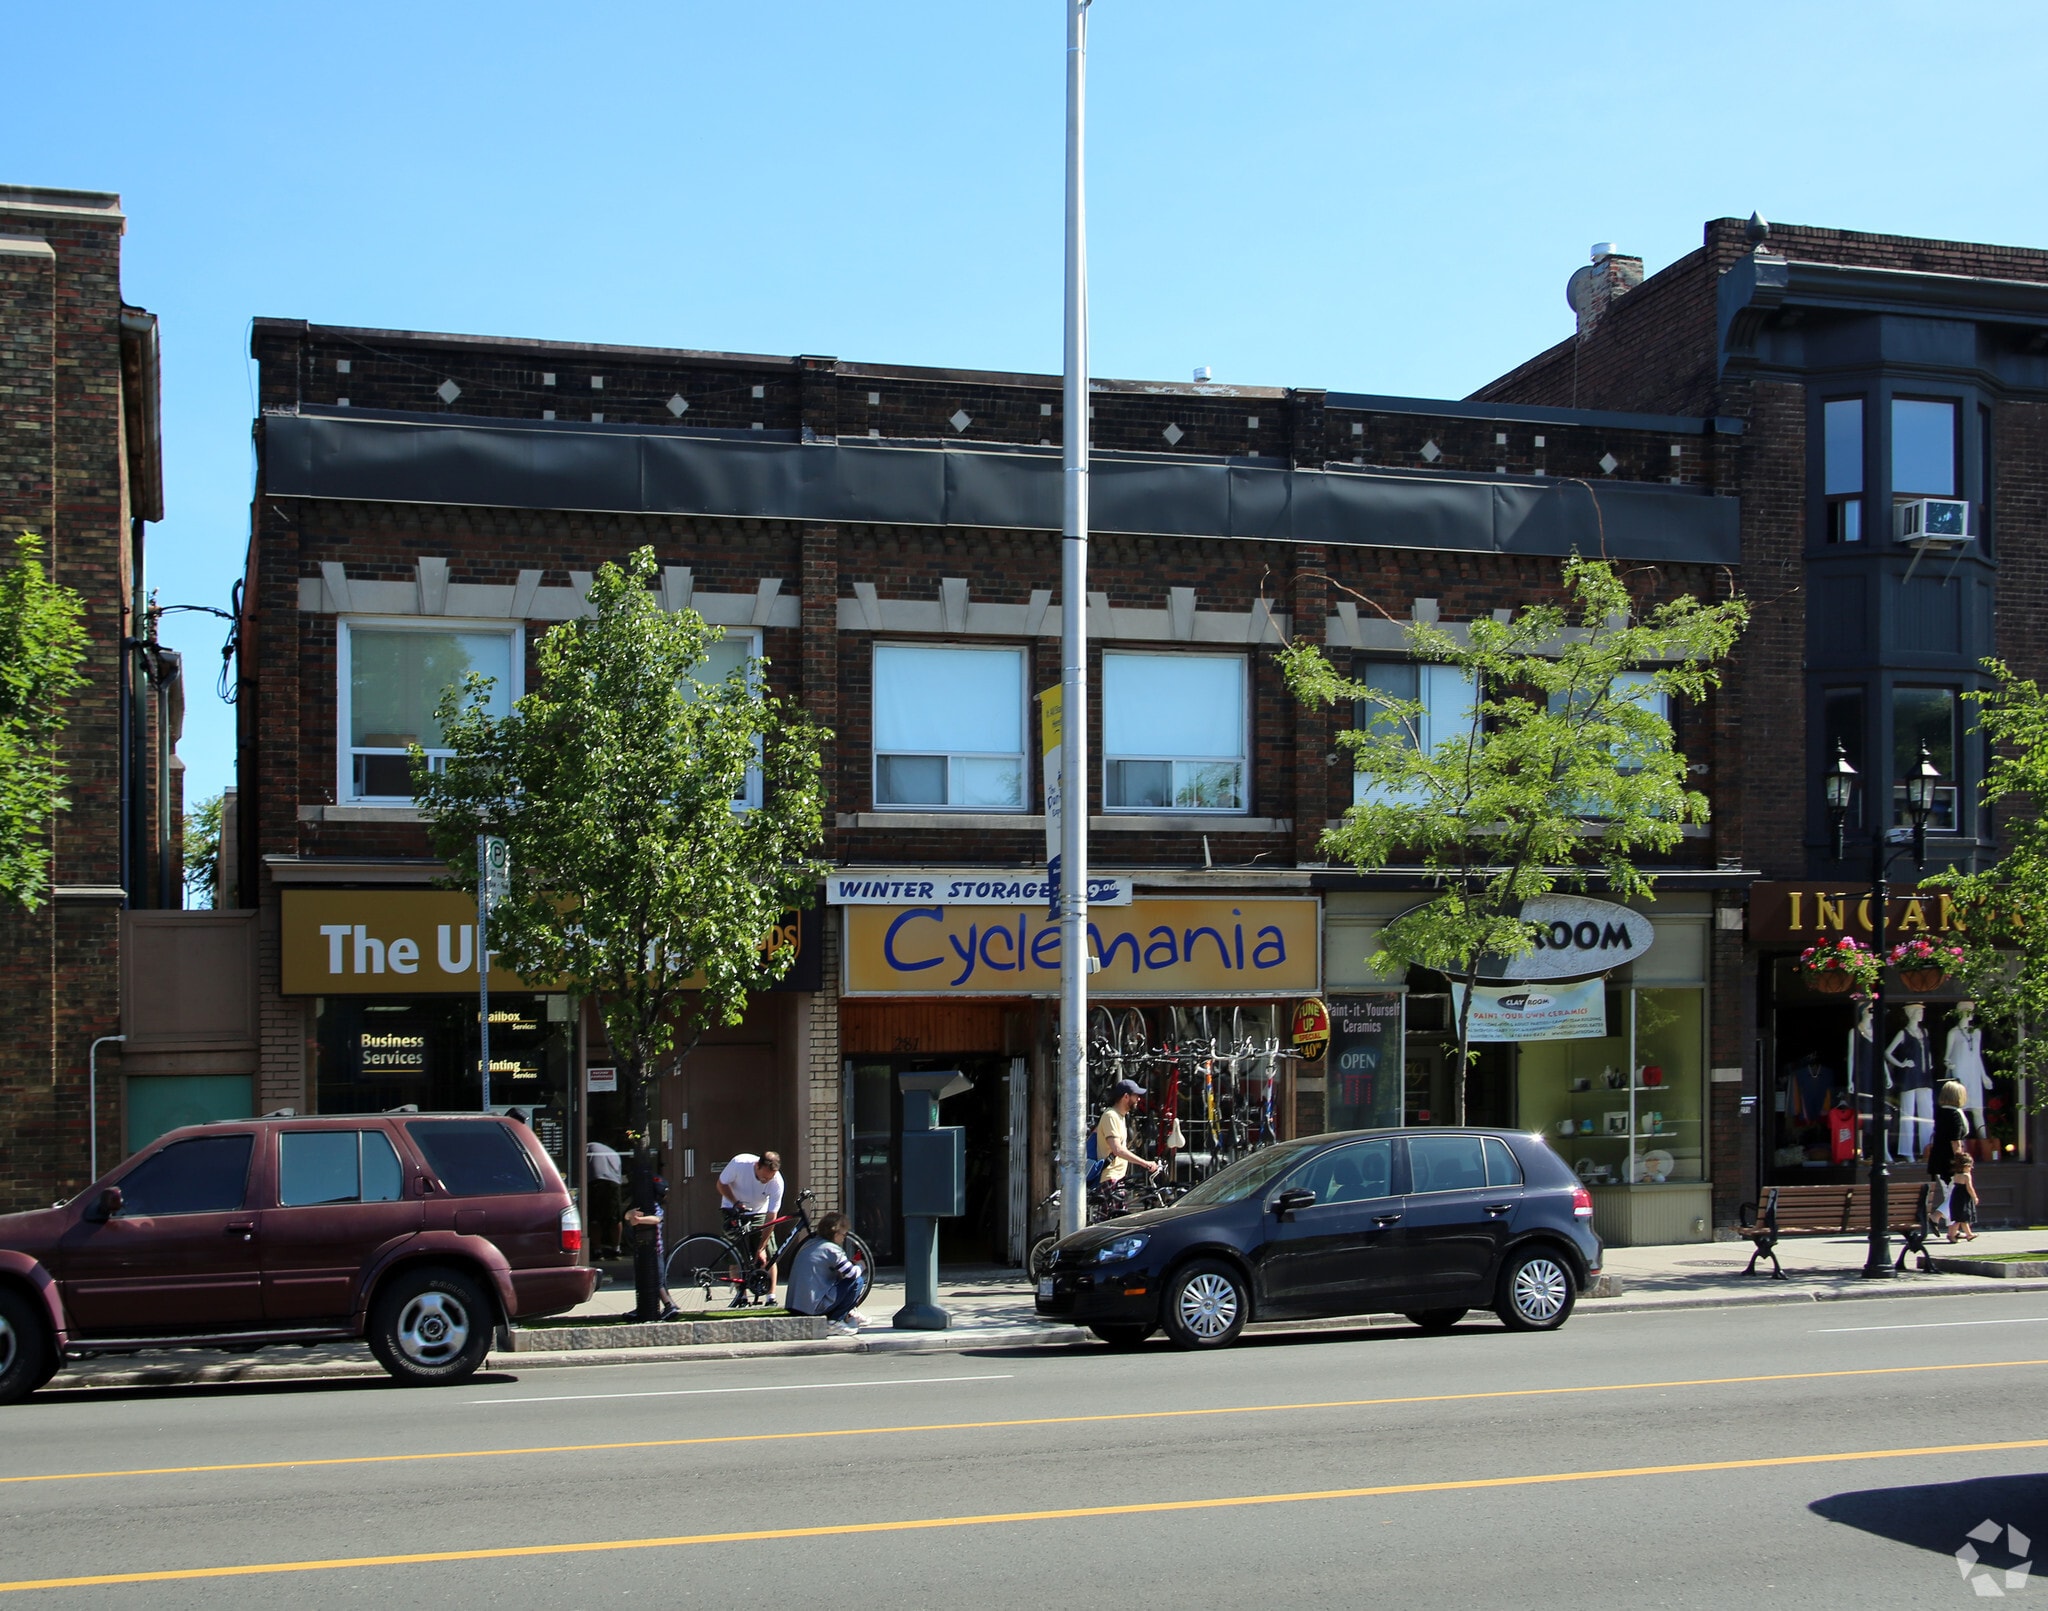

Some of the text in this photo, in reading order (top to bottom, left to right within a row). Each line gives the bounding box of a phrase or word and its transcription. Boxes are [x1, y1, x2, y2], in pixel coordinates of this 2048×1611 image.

[839, 882, 934, 899] WINTER
[948, 881, 1049, 899] STORAGE
[320, 925, 419, 974] The
[884, 905, 1287, 986] Cyclemania
[1299, 1002, 1320, 1019] TUNE
[1548, 1008, 1588, 1017] CERAMICS
[1302, 1018, 1315, 1032] UP
[1343, 1019, 1381, 1033] Ceramics
[361, 1033, 424, 1048] Business
[1298, 1033, 1322, 1042] SPECIAL
[363, 1050, 423, 1065] Services
[1341, 1053, 1376, 1069] OPEN
